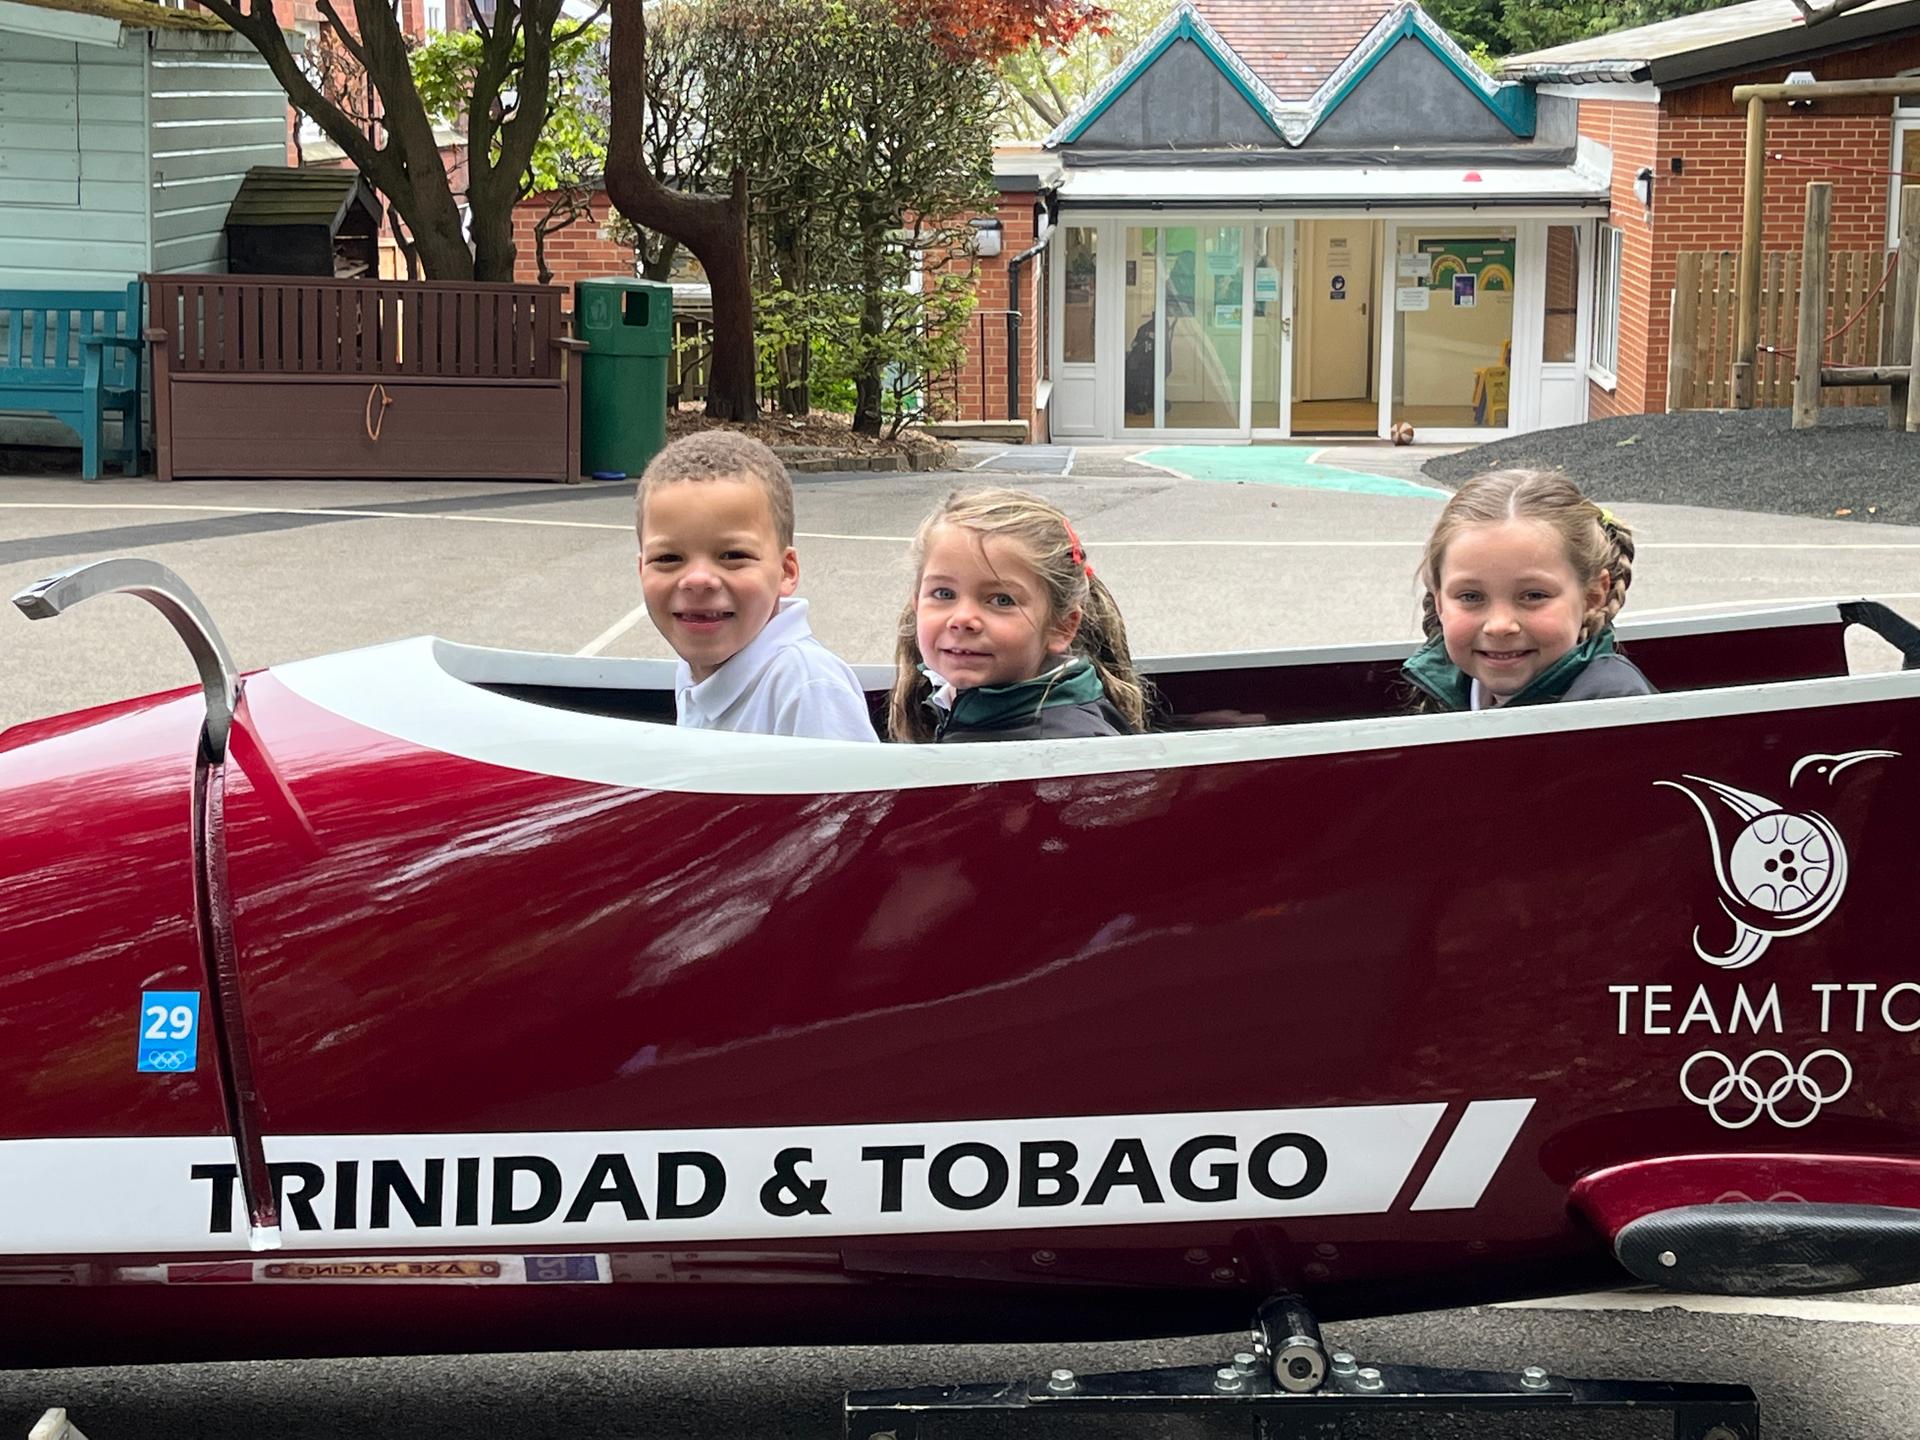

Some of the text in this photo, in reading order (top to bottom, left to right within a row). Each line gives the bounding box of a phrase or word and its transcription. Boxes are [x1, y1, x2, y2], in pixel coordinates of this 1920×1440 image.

[144, 1005, 194, 1040] 29
[1608, 983, 1783, 1036] TEAM
[190, 1132, 1329, 1234] TRINIDAD & TOBAGO
